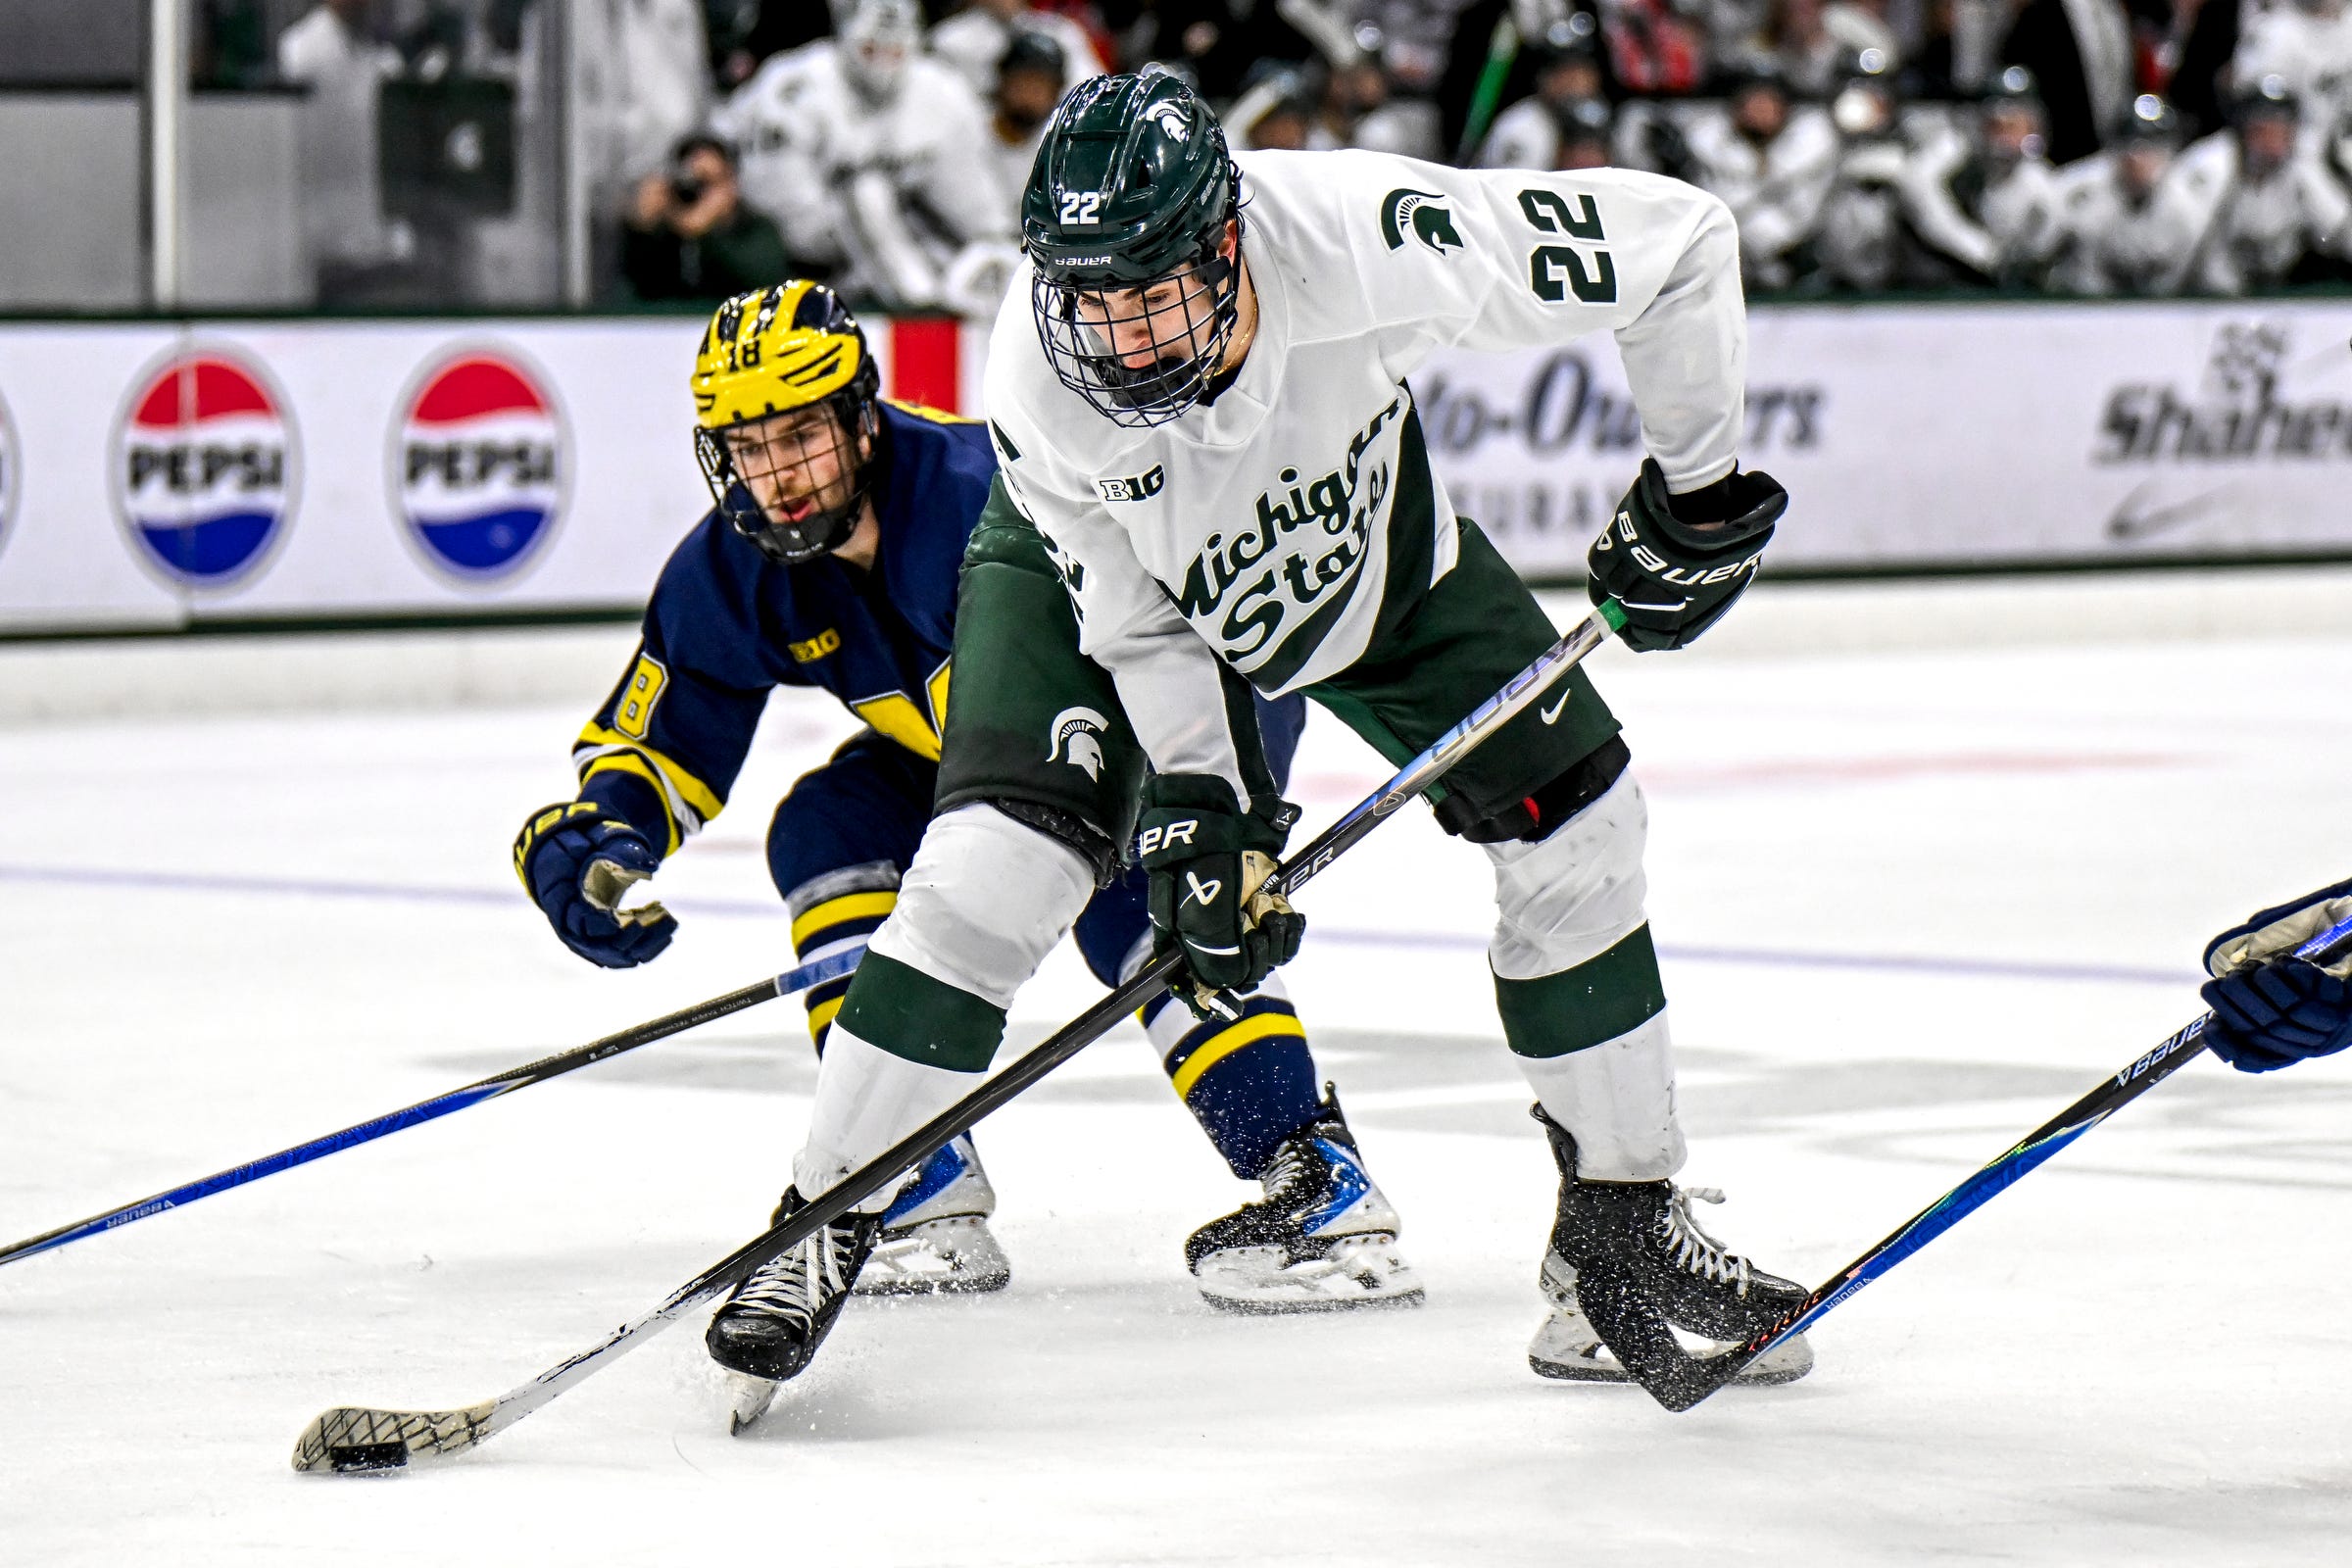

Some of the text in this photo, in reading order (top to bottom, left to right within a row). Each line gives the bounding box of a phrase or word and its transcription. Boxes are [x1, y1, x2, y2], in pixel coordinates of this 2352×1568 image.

[1059, 191, 1102, 226] 22
[1516, 188, 1617, 304] 22
[728, 340, 760, 372] 18
[128, 443, 283, 489] PEPSI
[406, 441, 556, 486] PEPSI
[1152, 397, 1400, 620] Michigan
[1221, 461, 1389, 663] State
